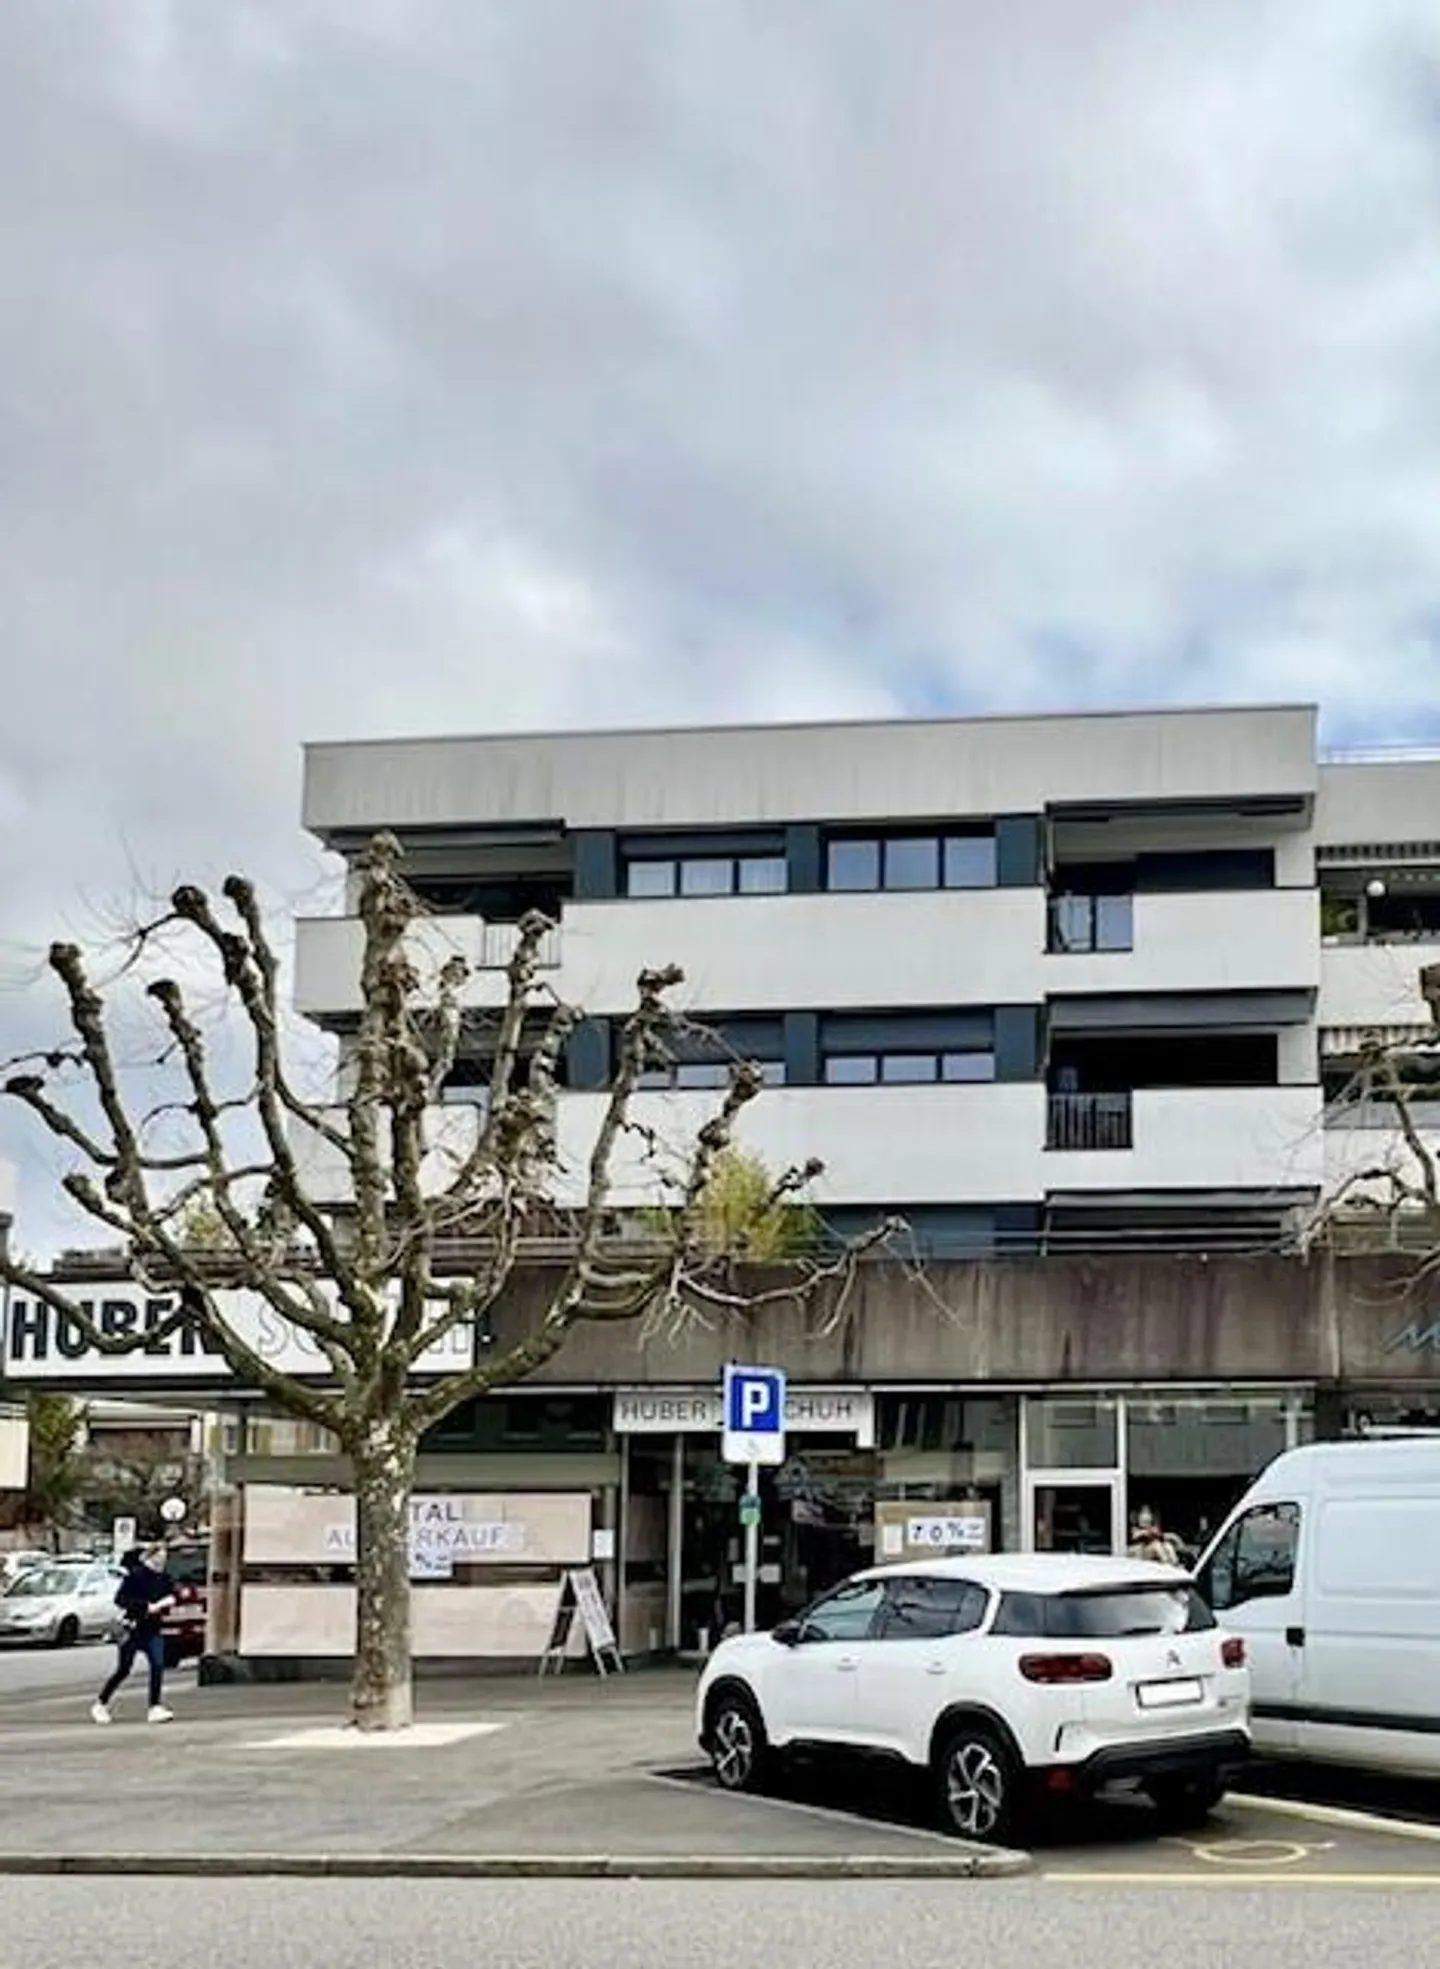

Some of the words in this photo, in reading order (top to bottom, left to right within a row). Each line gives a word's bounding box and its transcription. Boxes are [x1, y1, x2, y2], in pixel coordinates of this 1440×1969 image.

[621, 1400, 706, 1420] HUBER
[785, 1400, 851, 1422] CHUH
[742, 1381, 770, 1427] P
